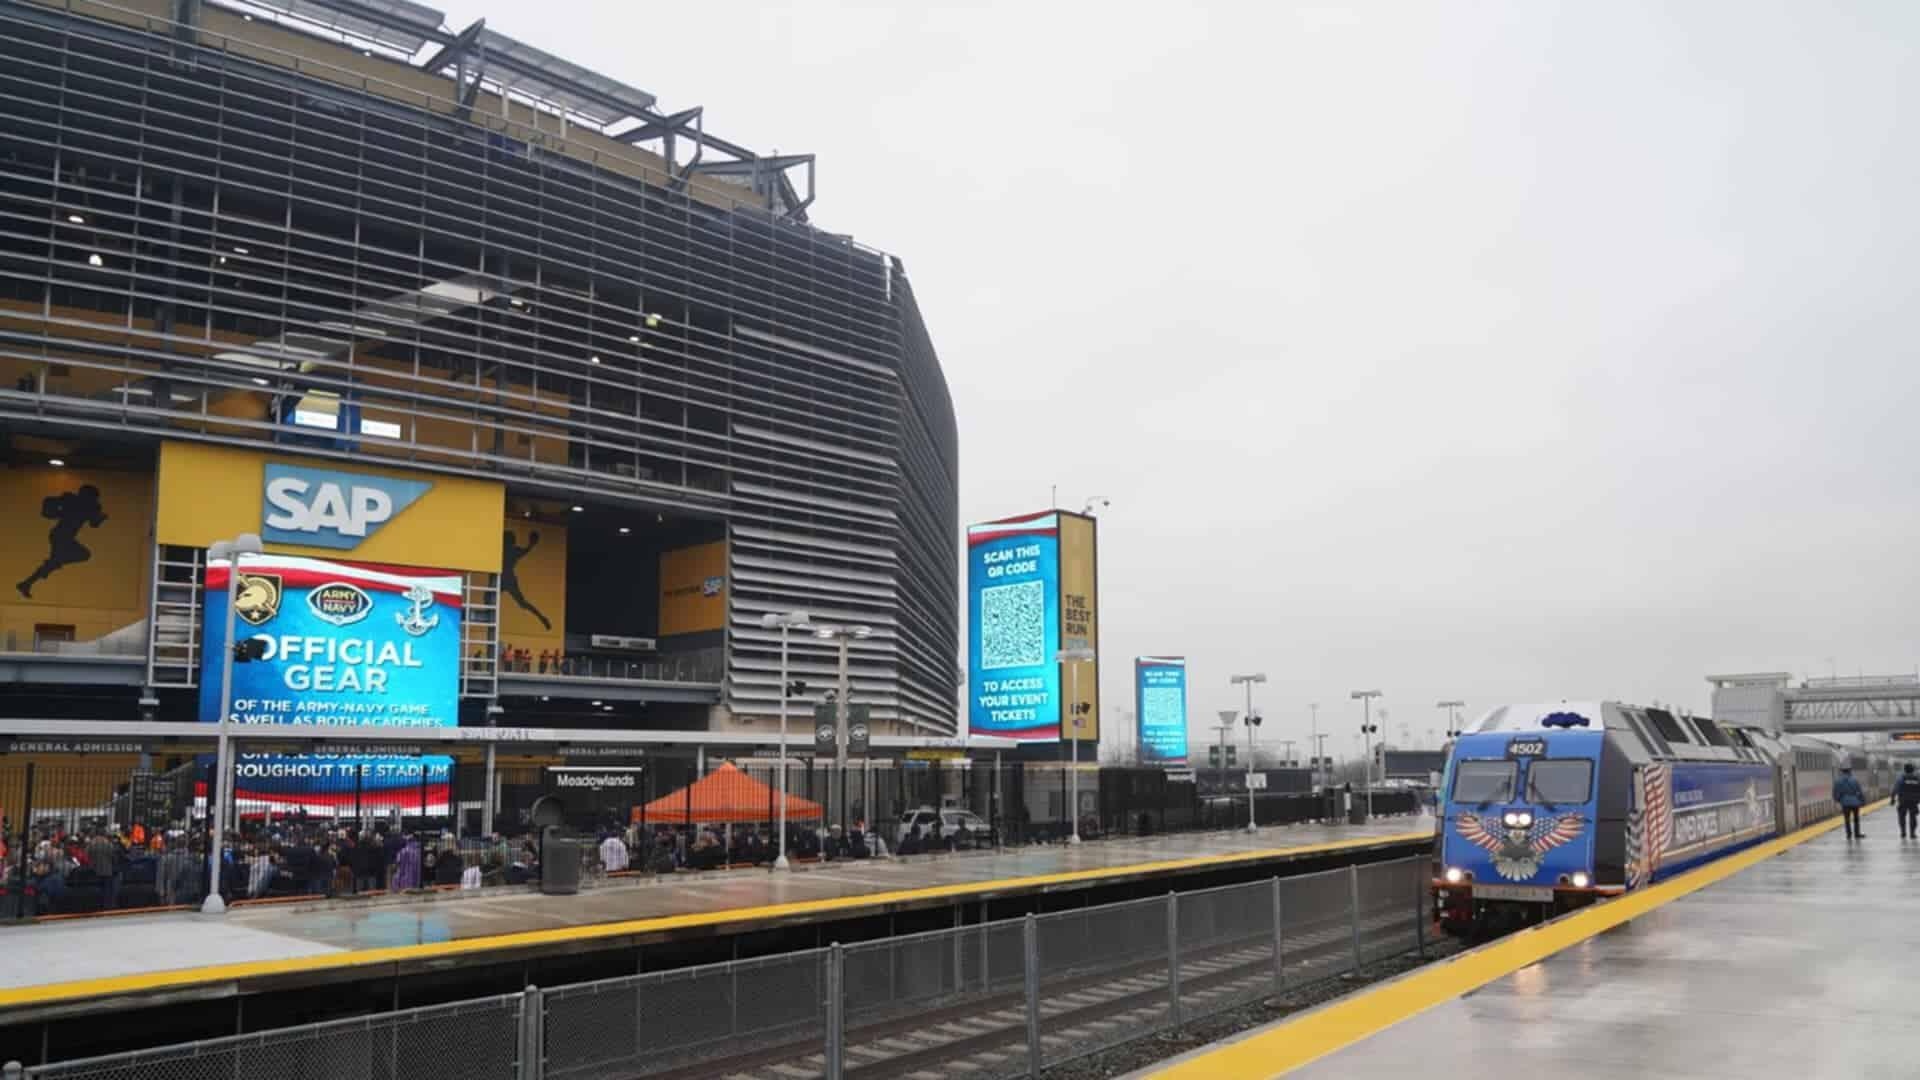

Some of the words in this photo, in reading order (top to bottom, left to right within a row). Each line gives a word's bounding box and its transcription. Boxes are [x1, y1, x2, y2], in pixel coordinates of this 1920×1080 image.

[266, 477, 393, 537] SAP
[983, 549, 1014, 564] SCAN
[1015, 544, 1041, 558] THIS
[1005, 560, 1037, 576] CODE
[322, 589, 357, 600] ARMY
[1065, 594, 1086, 608] THE
[322, 602, 357, 614] NAVY
[1065, 608, 1091, 624] BEST
[1066, 622, 1088, 636] RUN
[284, 665, 388, 693] GEAR
[983, 681, 999, 693] TO
[1001, 677, 1044, 692] ACCESS
[234, 699, 257, 711] OF
[263, 701, 292, 712] THE
[296, 701, 385, 713] ARMY-NAVY
[390, 703, 430, 714] GAME
[979, 695, 1010, 708] YOUR
[1011, 693, 1049, 706] EVENT
[991, 709, 1036, 722] TICKETS
[10, 743, 71, 752] GENERAL
[74, 743, 143, 752] ADMISSION
[1508, 742, 1544, 755] 4502
[235, 764, 335, 777] ROUGHOUT
[338, 764, 372, 777] THE
[557, 773, 636, 787] Meadowlands
